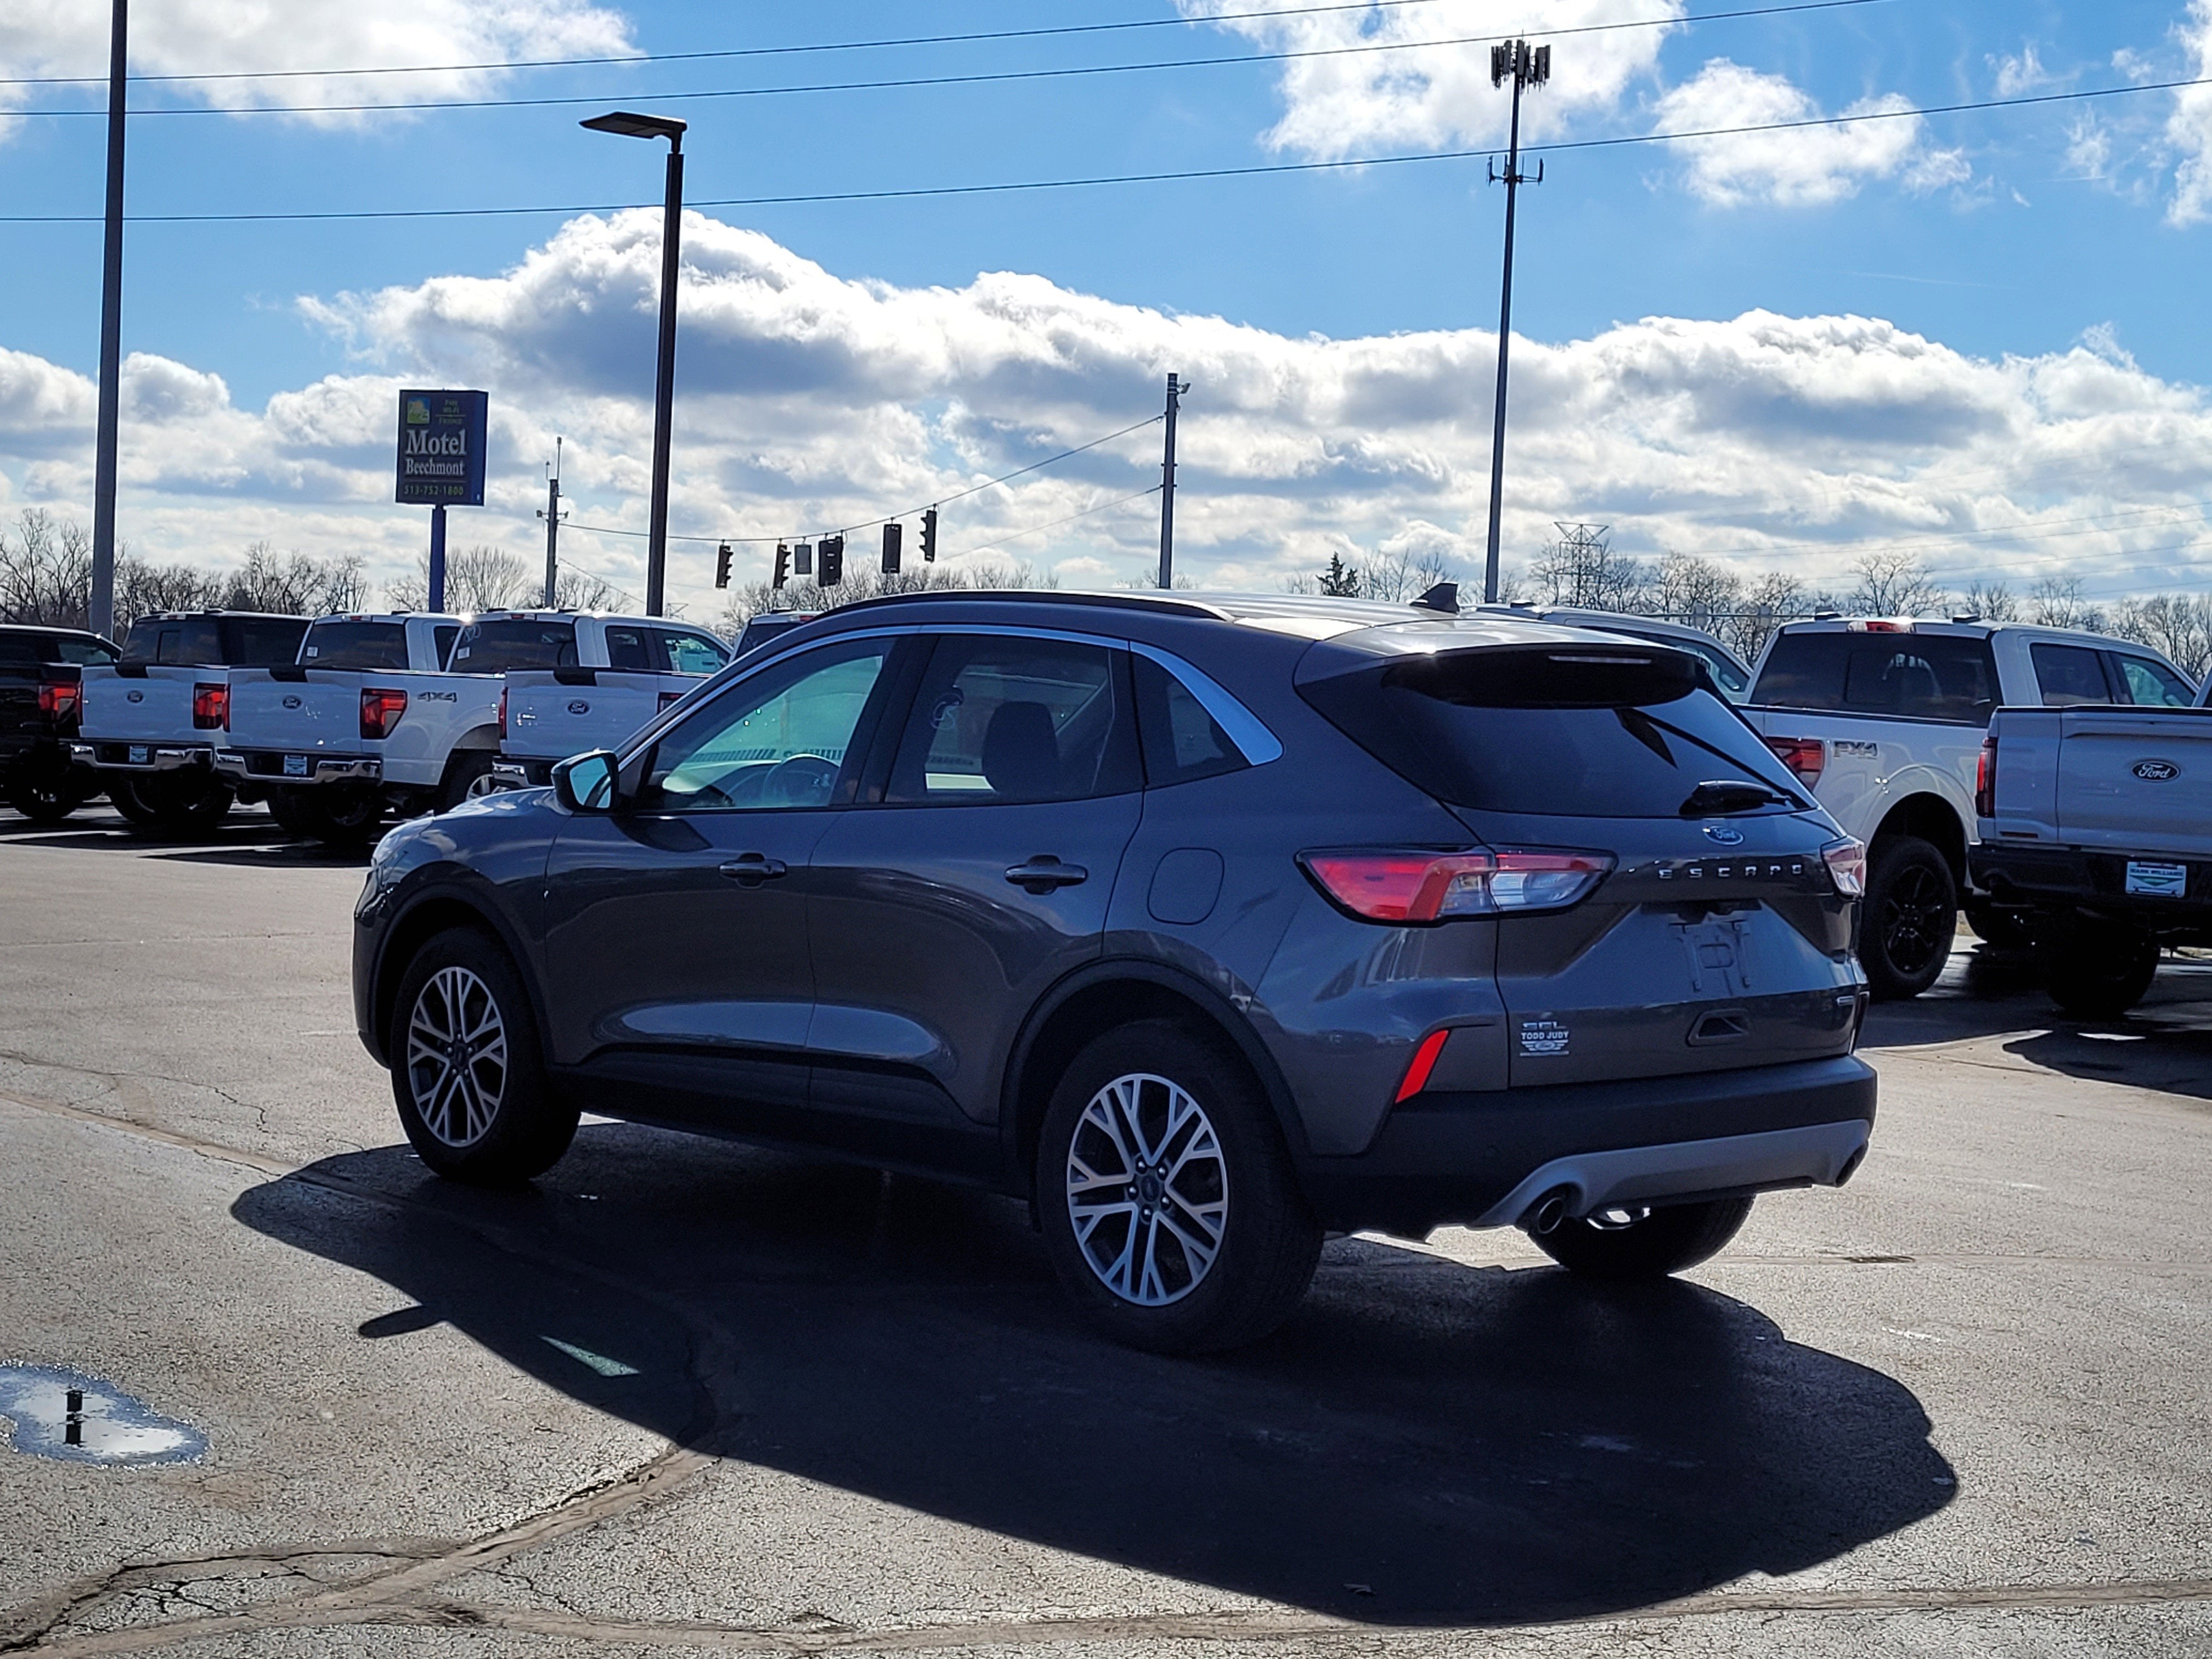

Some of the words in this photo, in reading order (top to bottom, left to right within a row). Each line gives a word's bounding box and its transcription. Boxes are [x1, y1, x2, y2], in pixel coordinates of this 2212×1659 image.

[405, 428, 466, 455] Motel
[405, 457, 464, 475] Beechmont
[1833, 741, 1878, 758] FX4
[2138, 764, 2171, 778] Ford
[1713, 827, 1736, 839] Ford
[1658, 864, 1803, 879] ESCAPE
